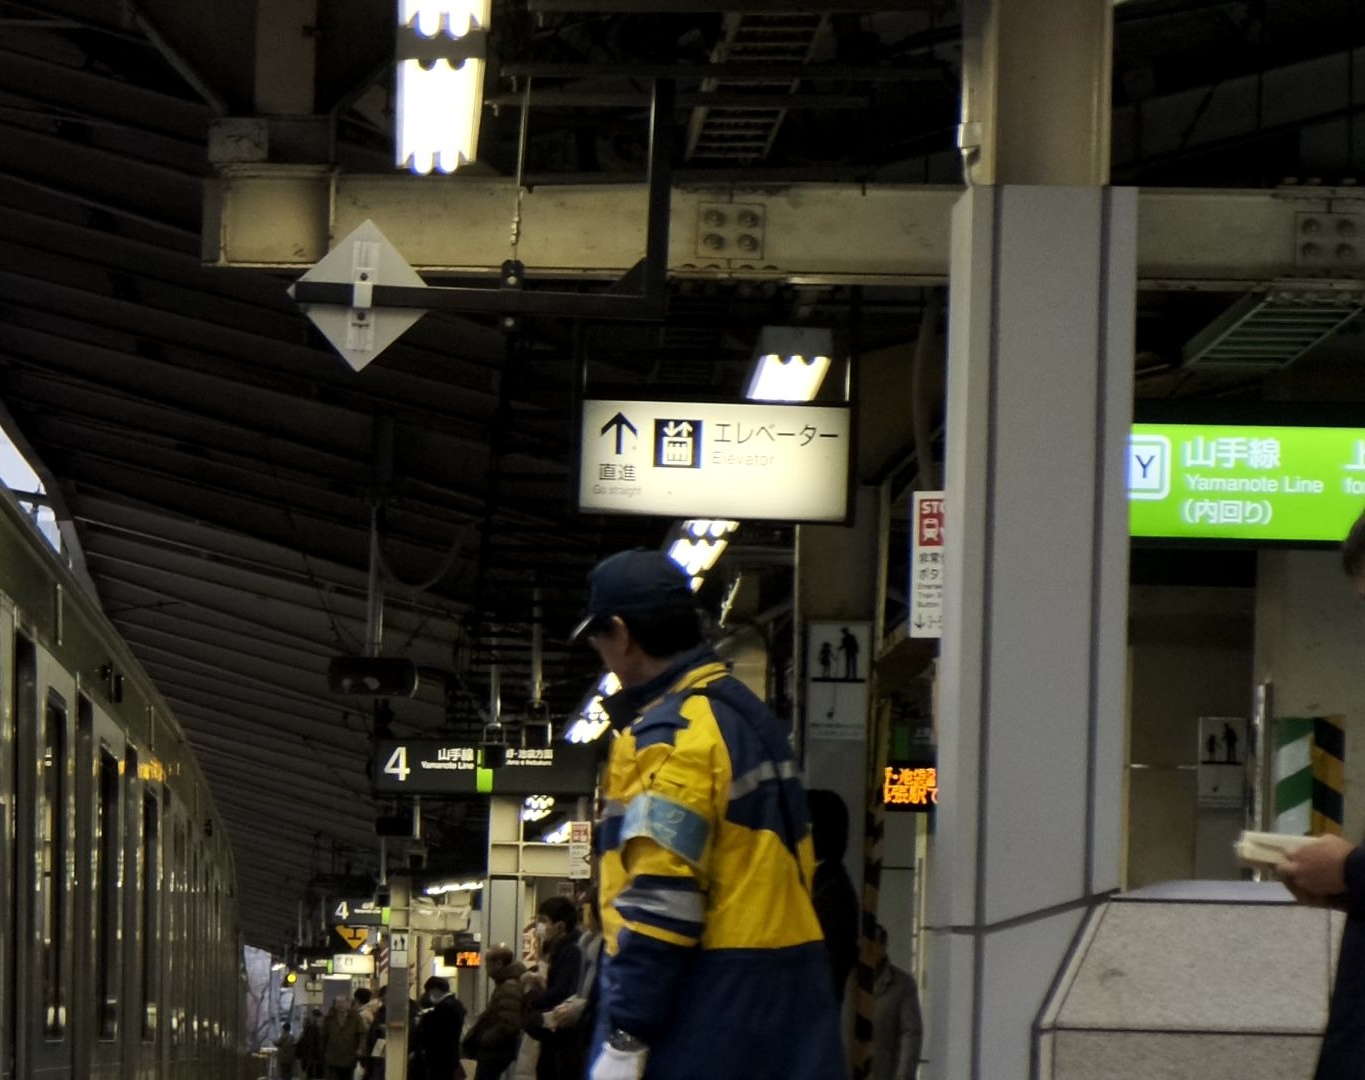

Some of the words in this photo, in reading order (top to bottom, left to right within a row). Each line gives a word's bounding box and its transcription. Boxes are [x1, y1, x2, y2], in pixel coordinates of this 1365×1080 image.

[713, 422, 838, 446] エレベーター
[712, 452, 774, 466] Elevator
[1183, 436, 1281, 468] 山手線
[599, 463, 637, 481] 直進
[1135, 455, 1155, 479] Y
[1186, 474, 1278, 492] Yamanote
[1284, 477, 1324, 493] Line
[1183, 499, 1273, 525] (内回り)
[384, 746, 410, 781] 4
[335, 901, 349, 919] 4
